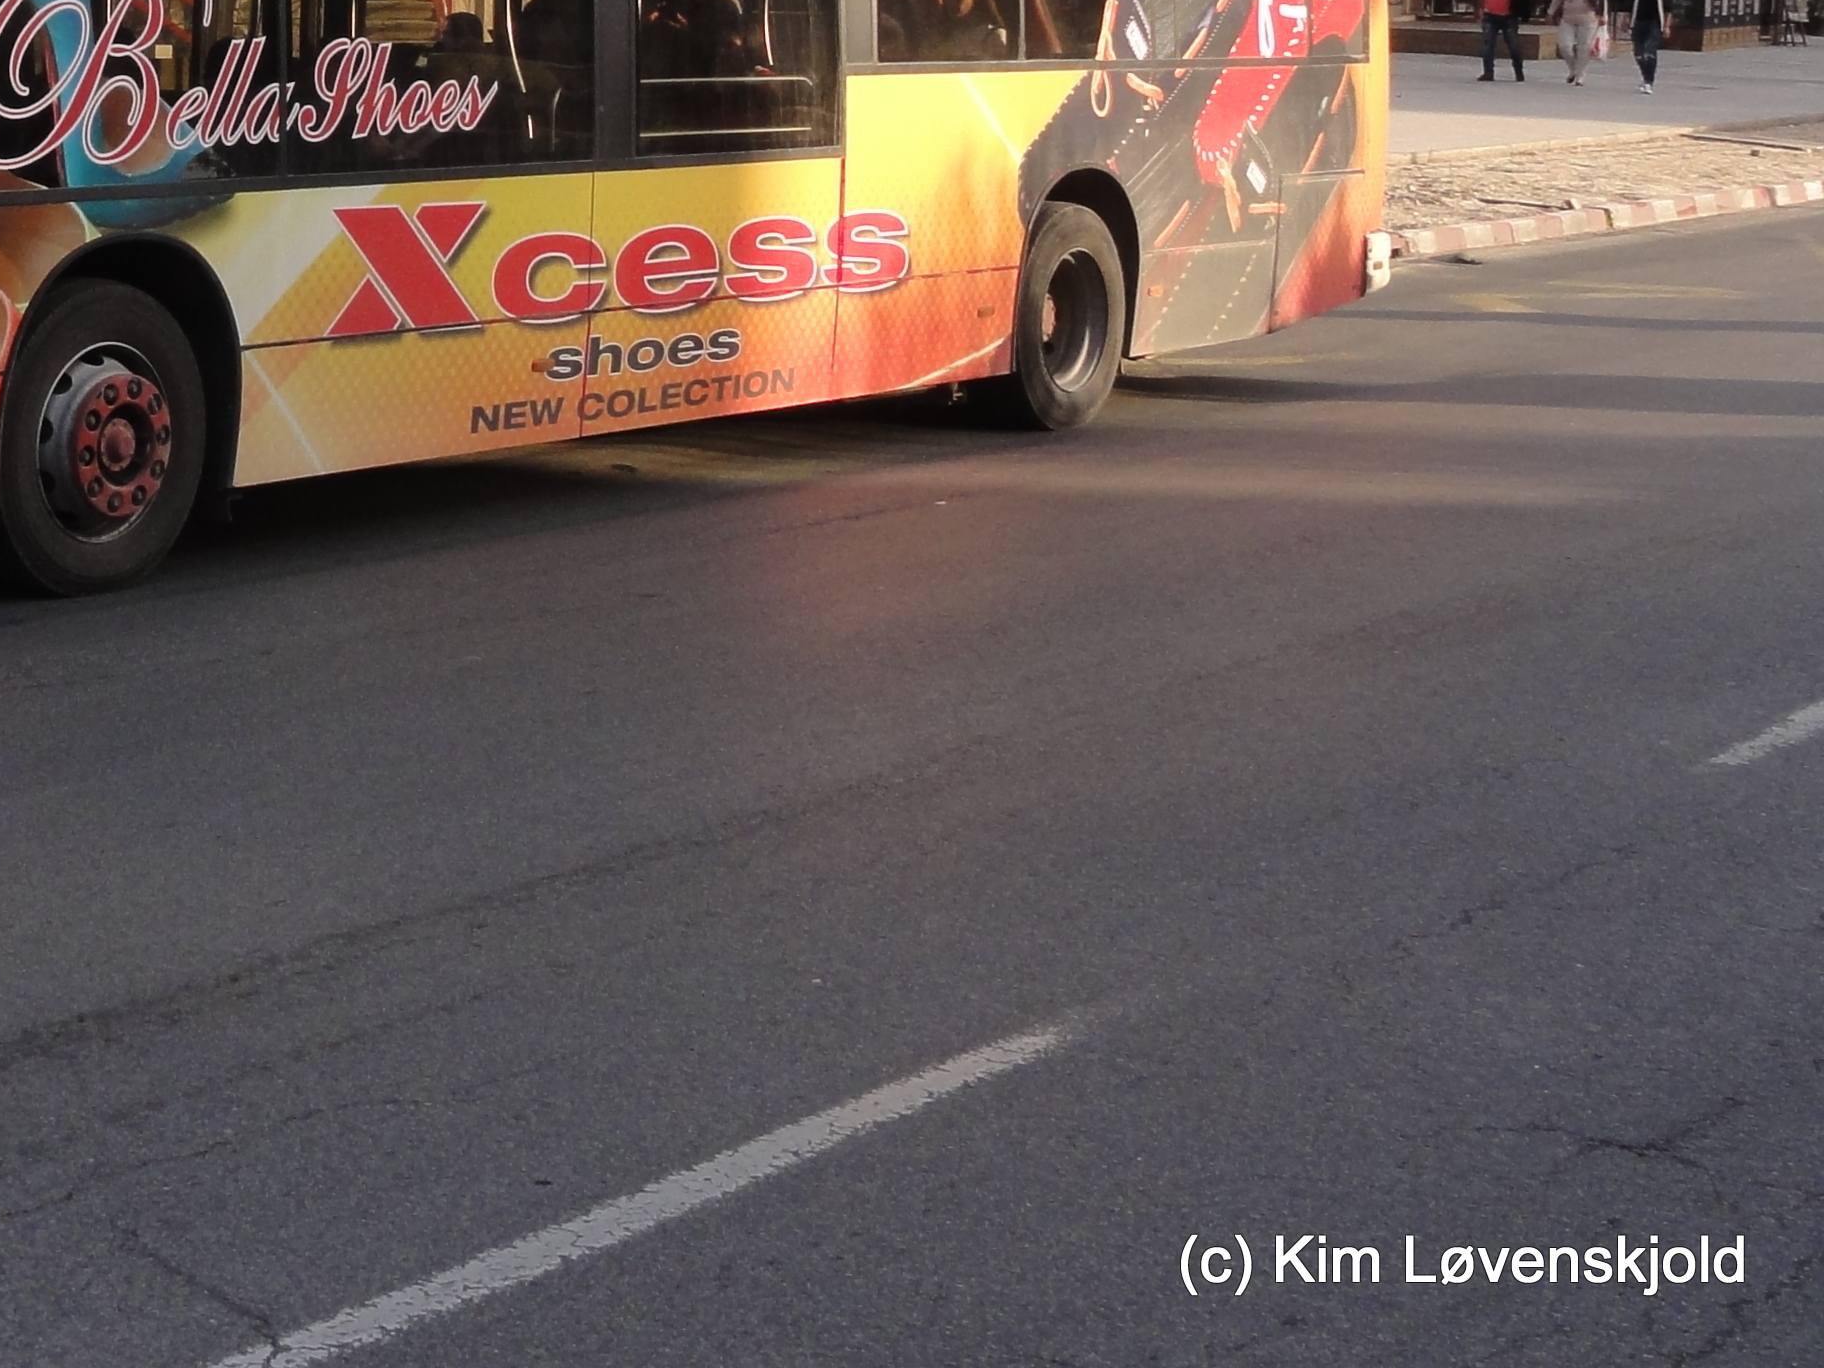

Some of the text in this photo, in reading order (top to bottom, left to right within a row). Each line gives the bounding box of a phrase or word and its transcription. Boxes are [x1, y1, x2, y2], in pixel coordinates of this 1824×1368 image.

[298, 37, 498, 142] Shoes
[324, 201, 908, 337] Xcess
[545, 329, 741, 380] shoes
[471, 368, 794, 434] NEW COLECTION
